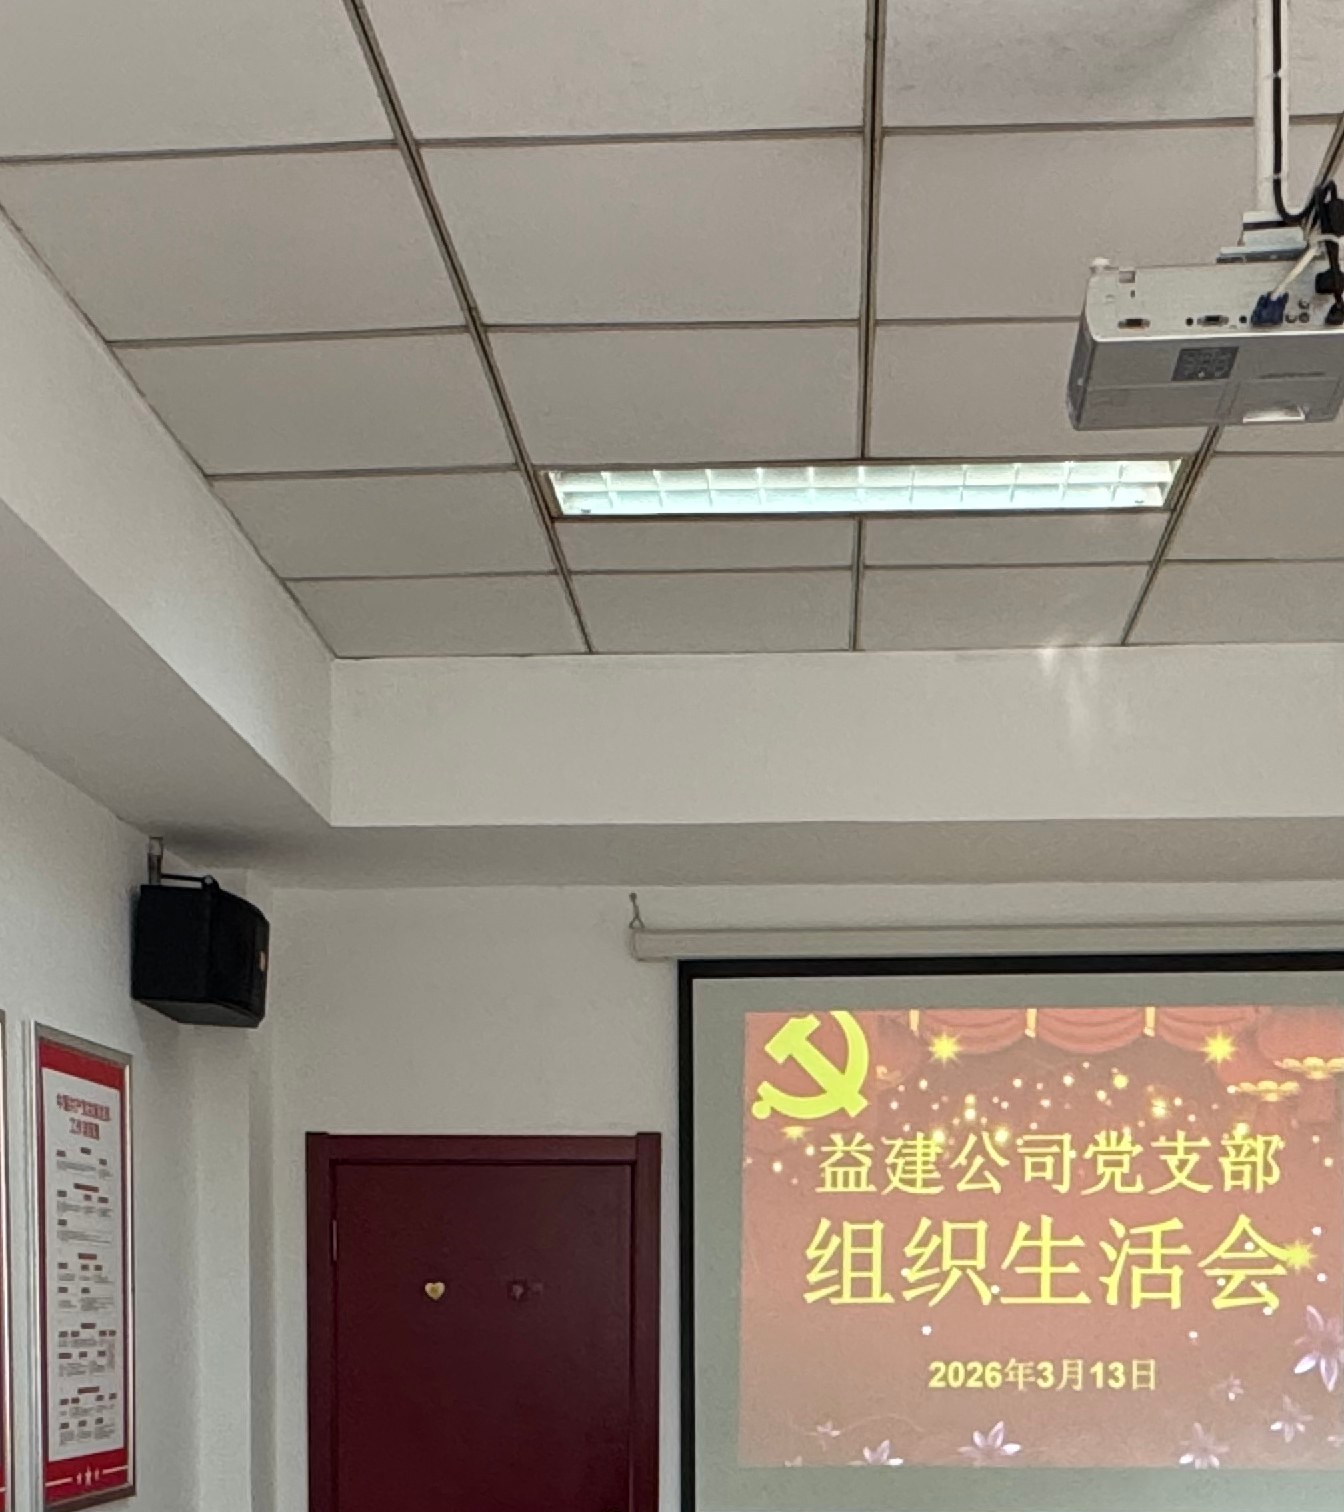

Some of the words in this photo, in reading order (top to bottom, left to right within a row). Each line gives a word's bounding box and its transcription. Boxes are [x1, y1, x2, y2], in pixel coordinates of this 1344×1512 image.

[816, 1131, 1286, 1194] 益建公司党支部
[803, 1215, 1290, 1311] 组织生活会
[929, 1358, 1157, 1392] 2026年3月13日
